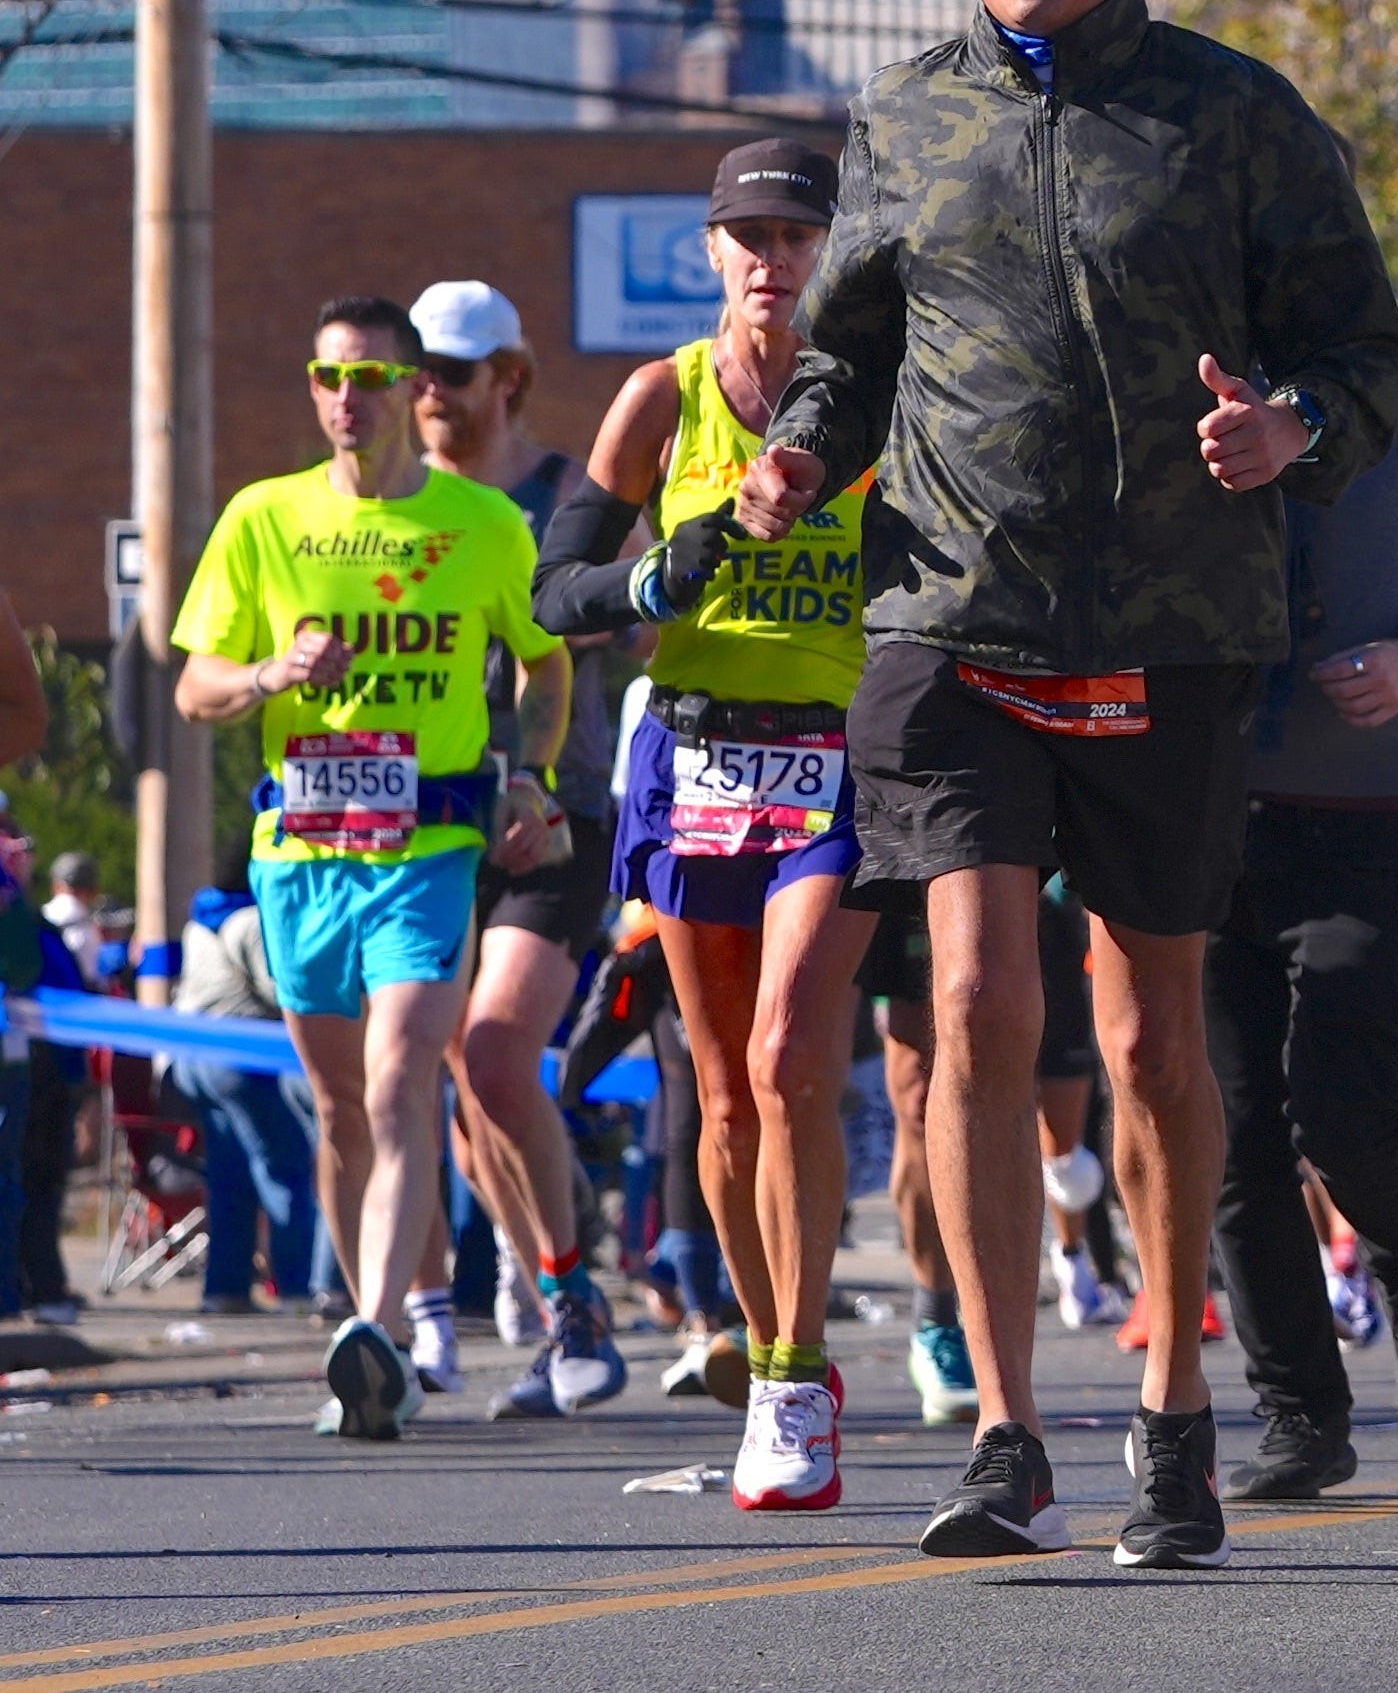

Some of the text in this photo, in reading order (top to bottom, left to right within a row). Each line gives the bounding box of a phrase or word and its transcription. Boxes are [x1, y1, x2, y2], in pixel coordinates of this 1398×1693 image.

[790, 173, 813, 187] CITY
[294, 530, 415, 557] Achilles
[723, 549, 860, 587] TEAM
[731, 587, 743, 620] FOR
[747, 585, 854, 626] KIDS
[1089, 702, 1127, 718] 2024
[296, 761, 404, 797] 14556
[695, 747, 824, 796] 25178
[761, 794, 768, 804] E
